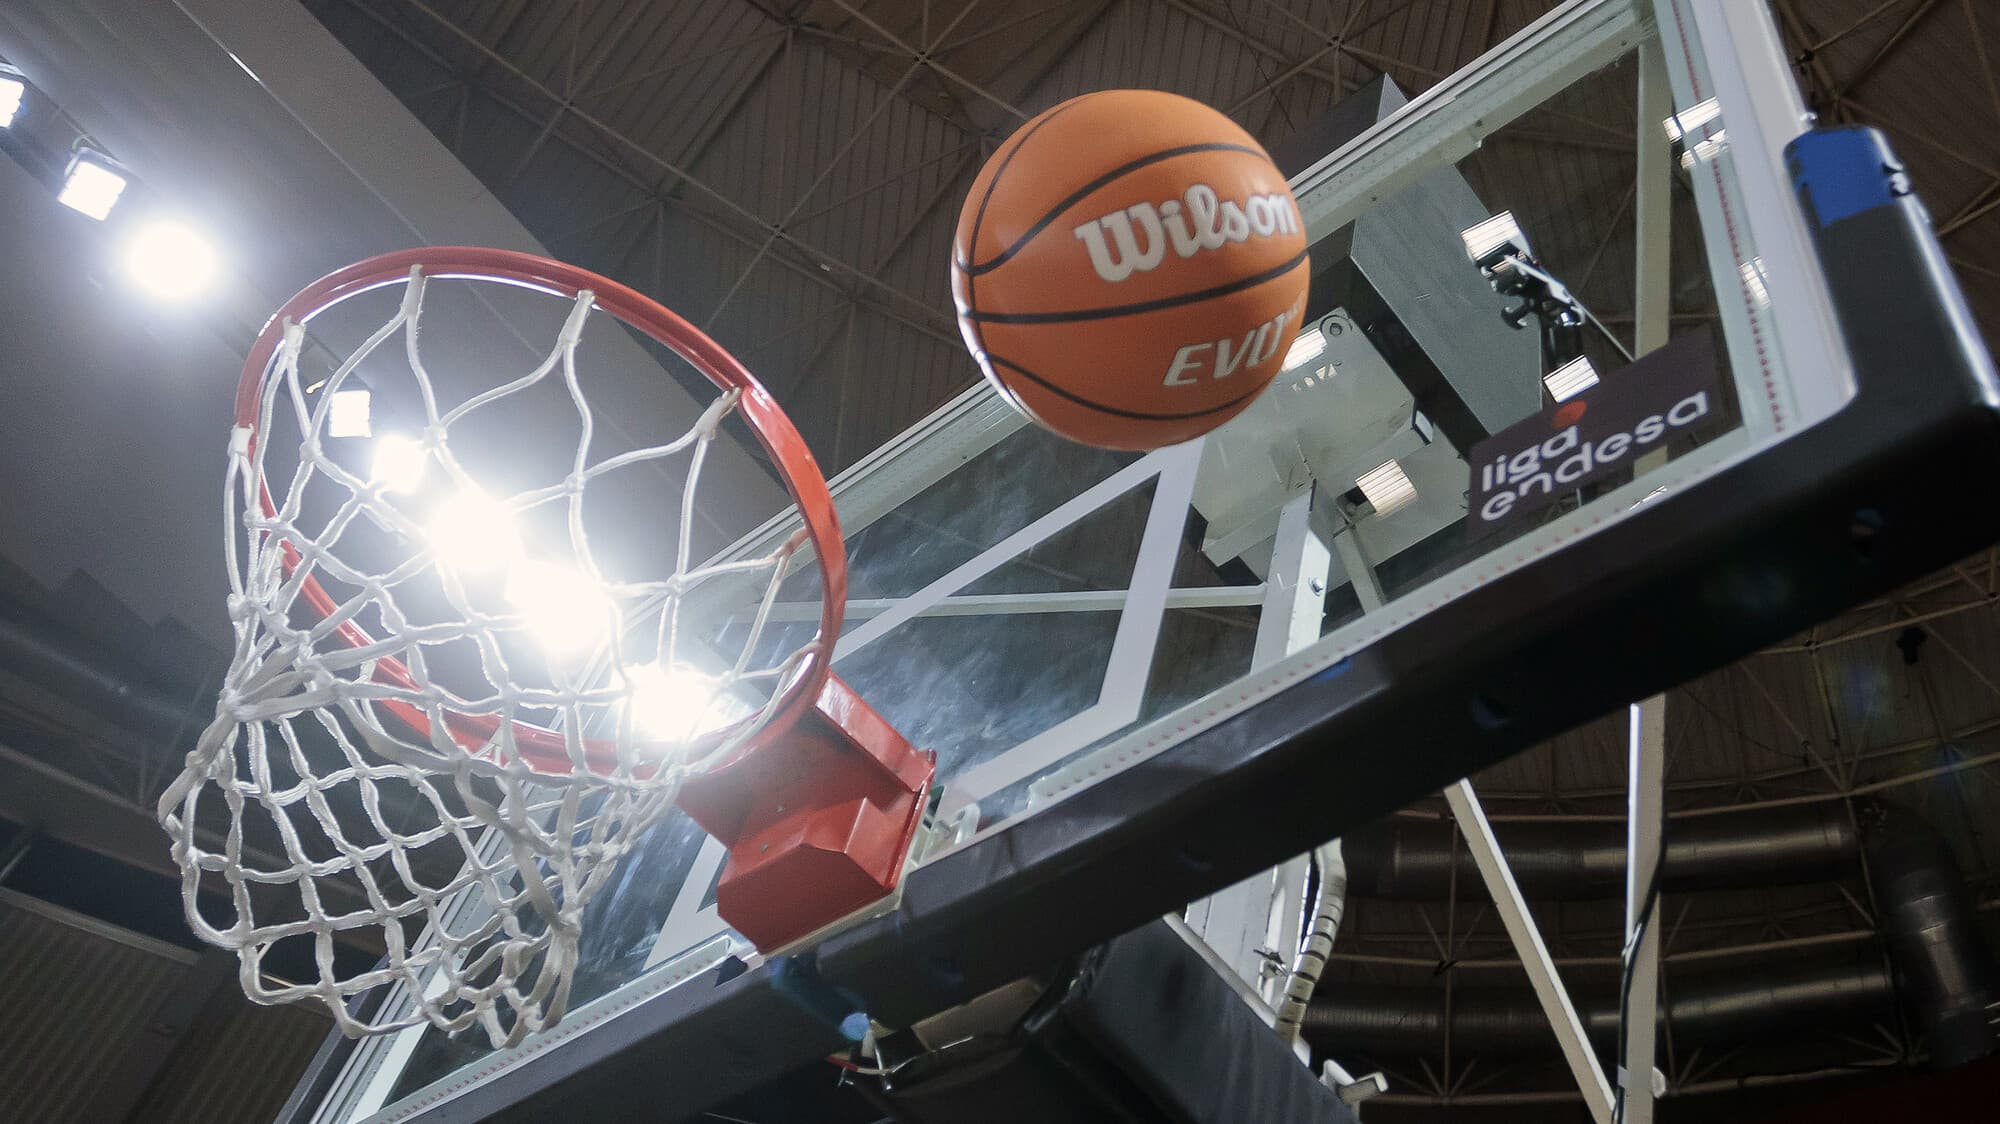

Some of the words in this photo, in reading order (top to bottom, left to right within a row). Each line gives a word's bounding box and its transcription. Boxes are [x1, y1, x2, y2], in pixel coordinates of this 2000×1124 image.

[1073, 183, 1298, 283] Wilson
[1480, 390, 1709, 521] endesa
[1481, 424, 1579, 492] liga
